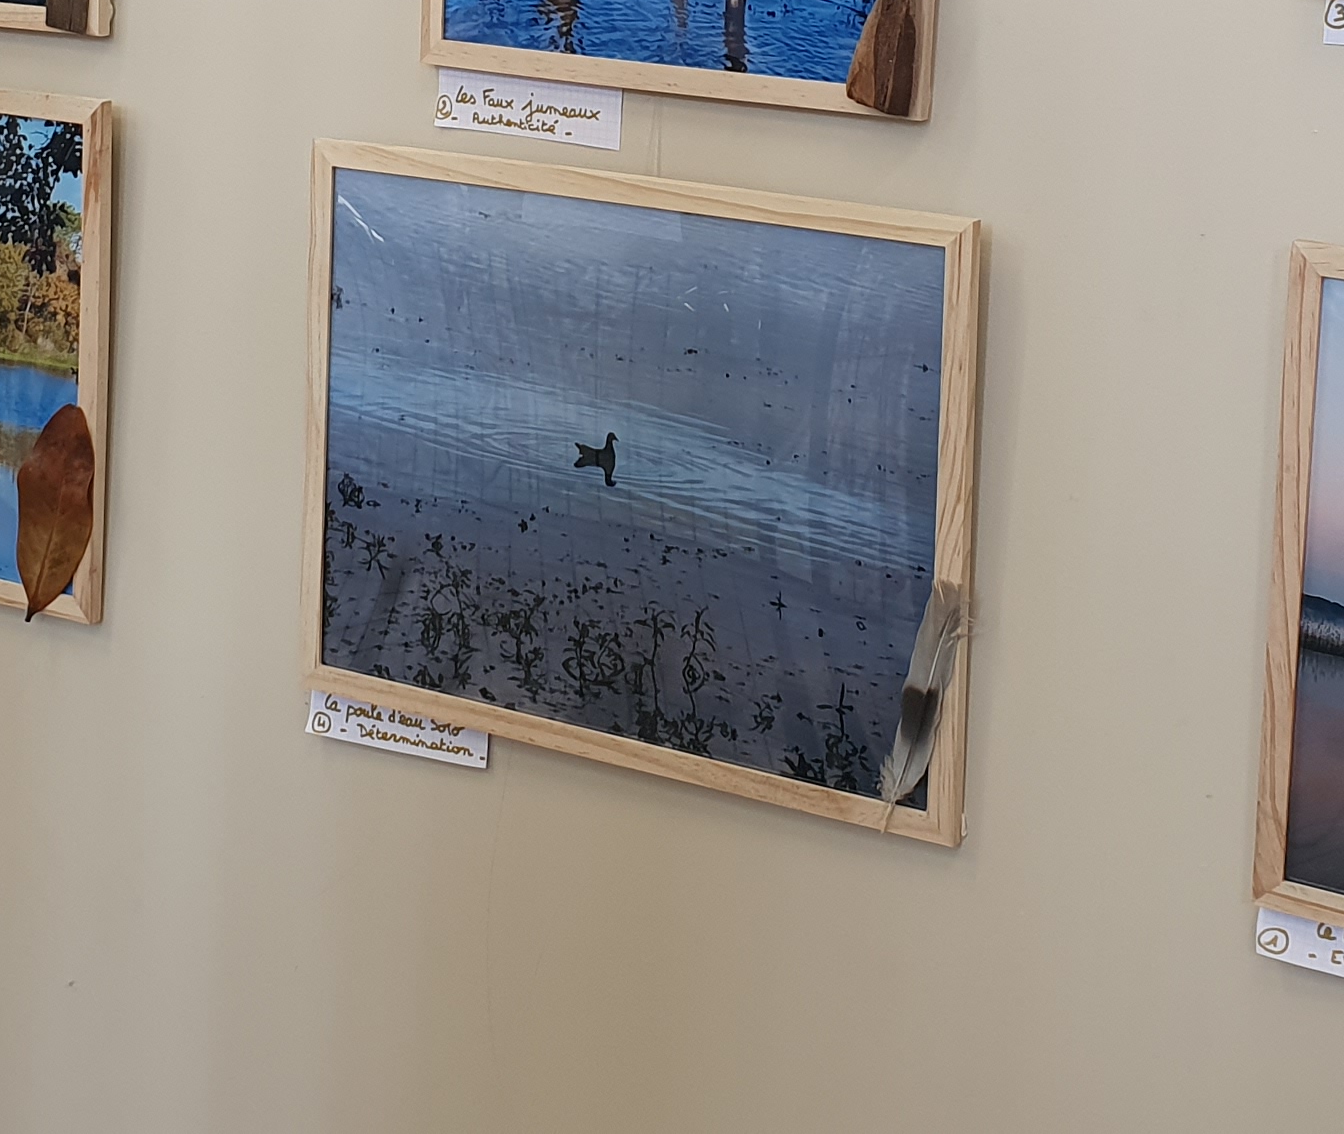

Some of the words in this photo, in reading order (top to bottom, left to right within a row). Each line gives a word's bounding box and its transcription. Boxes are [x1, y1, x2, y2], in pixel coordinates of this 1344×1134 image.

[482, 88, 515, 110] Faux
[521, 92, 601, 121] jumeaux
[356, 723, 474, 757] Détermination
